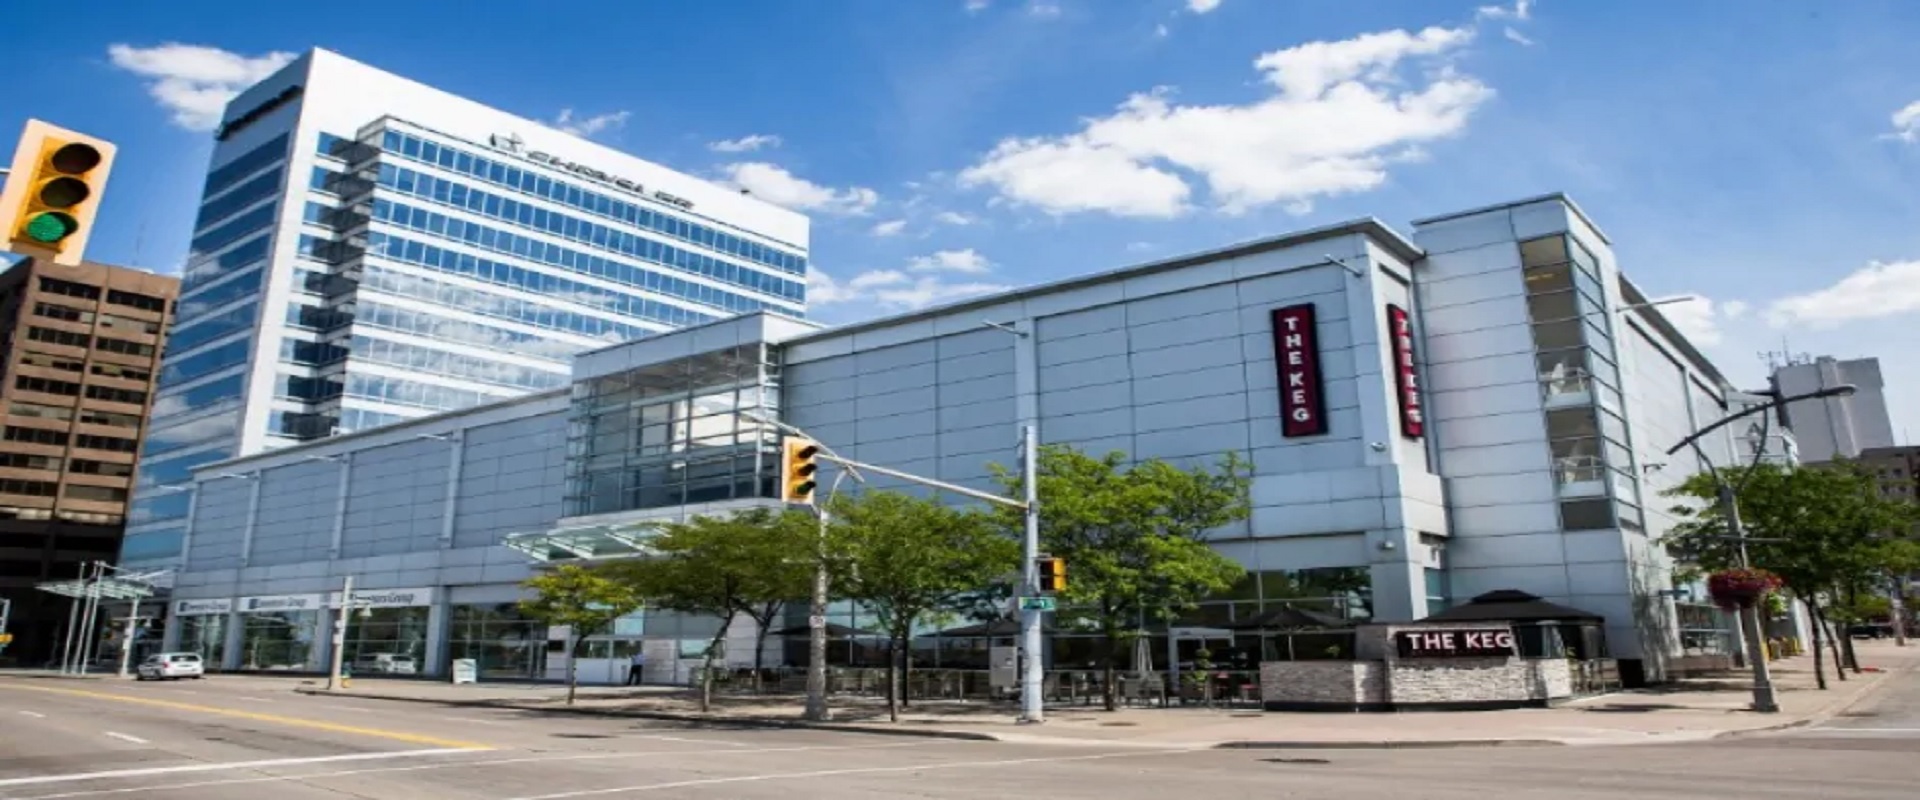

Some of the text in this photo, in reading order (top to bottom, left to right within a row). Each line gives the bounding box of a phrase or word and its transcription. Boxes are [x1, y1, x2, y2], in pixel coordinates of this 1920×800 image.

[1284, 316, 1311, 422] THE KEG
[1406, 632, 1513, 650] THE KEG
